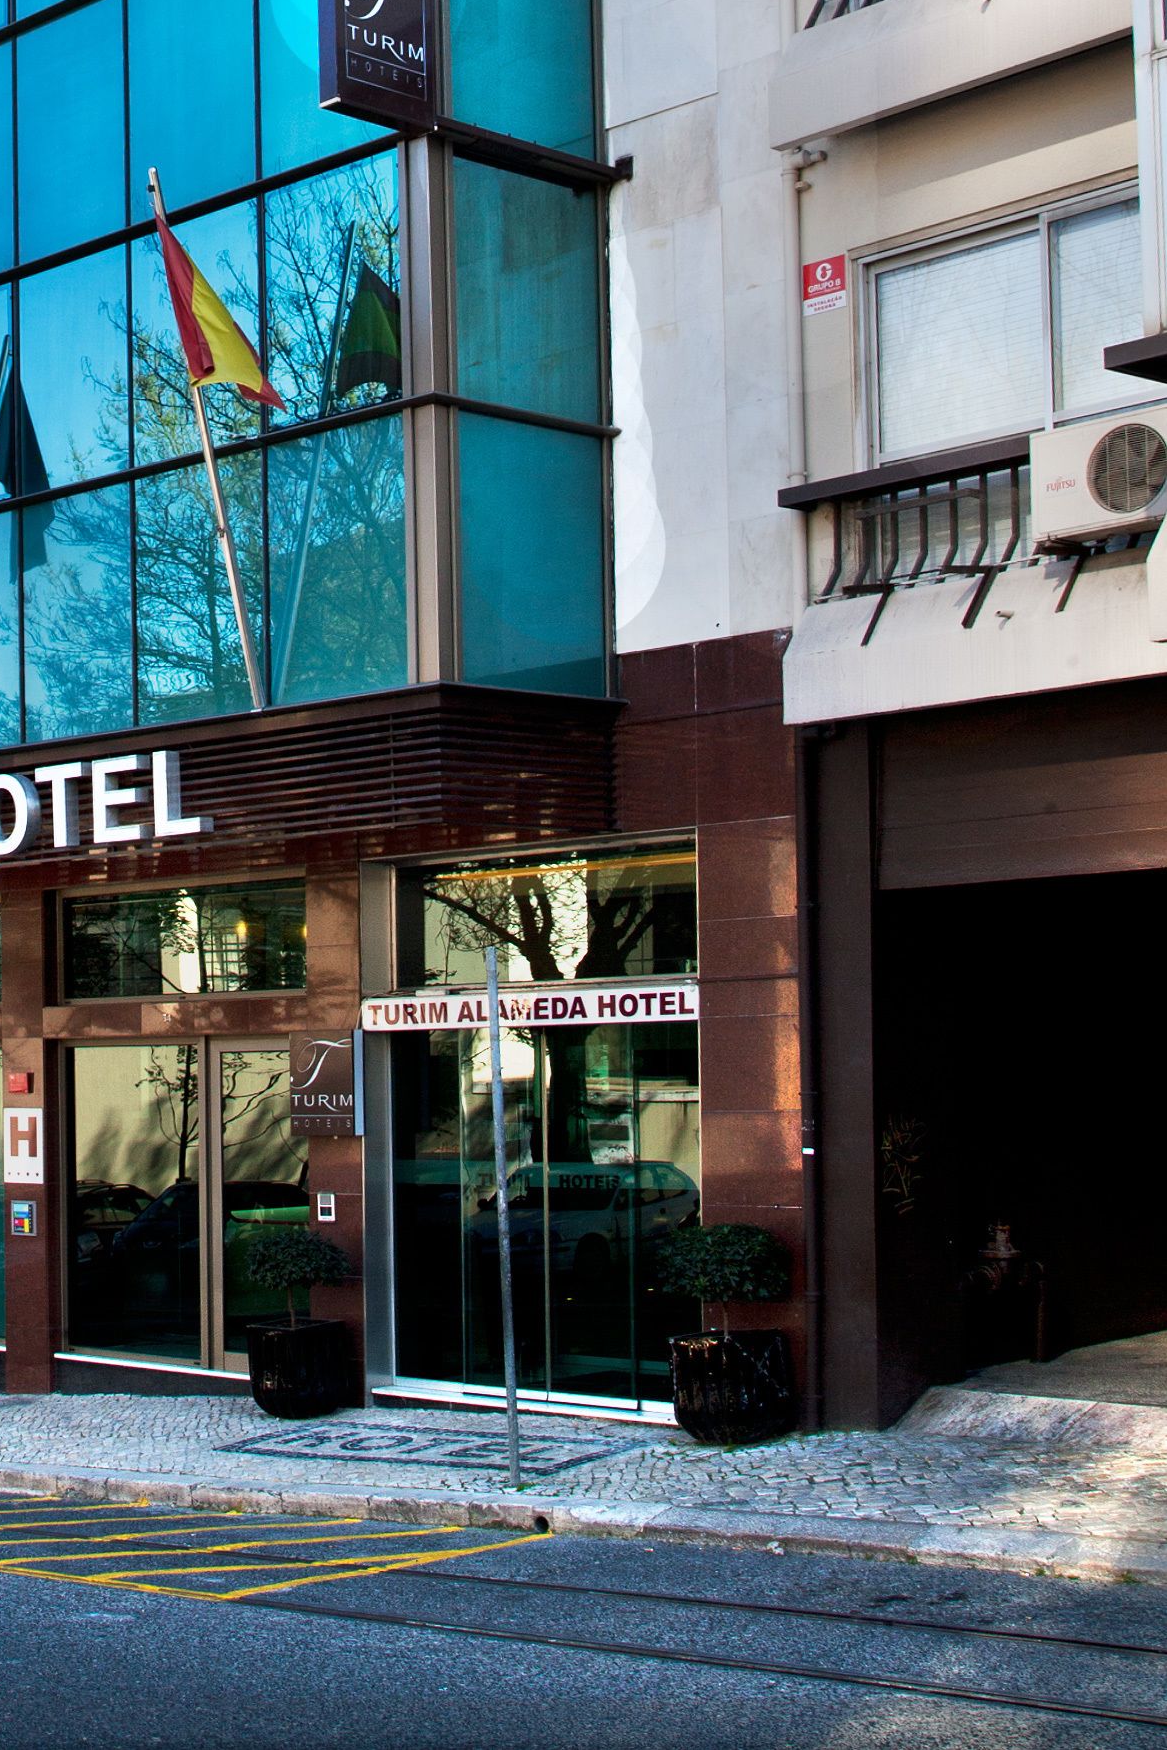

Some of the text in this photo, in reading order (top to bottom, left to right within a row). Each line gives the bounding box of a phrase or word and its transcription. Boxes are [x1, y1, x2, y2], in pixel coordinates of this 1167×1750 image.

[347, 24, 424, 63] TURIM
[1046, 479, 1075, 492] FUJITSU
[367, 991, 695, 1025] TURIM ALAMEDA HOTEL
[291, 1094, 353, 1112] TURIM
[10, 1116, 37, 1158] H
